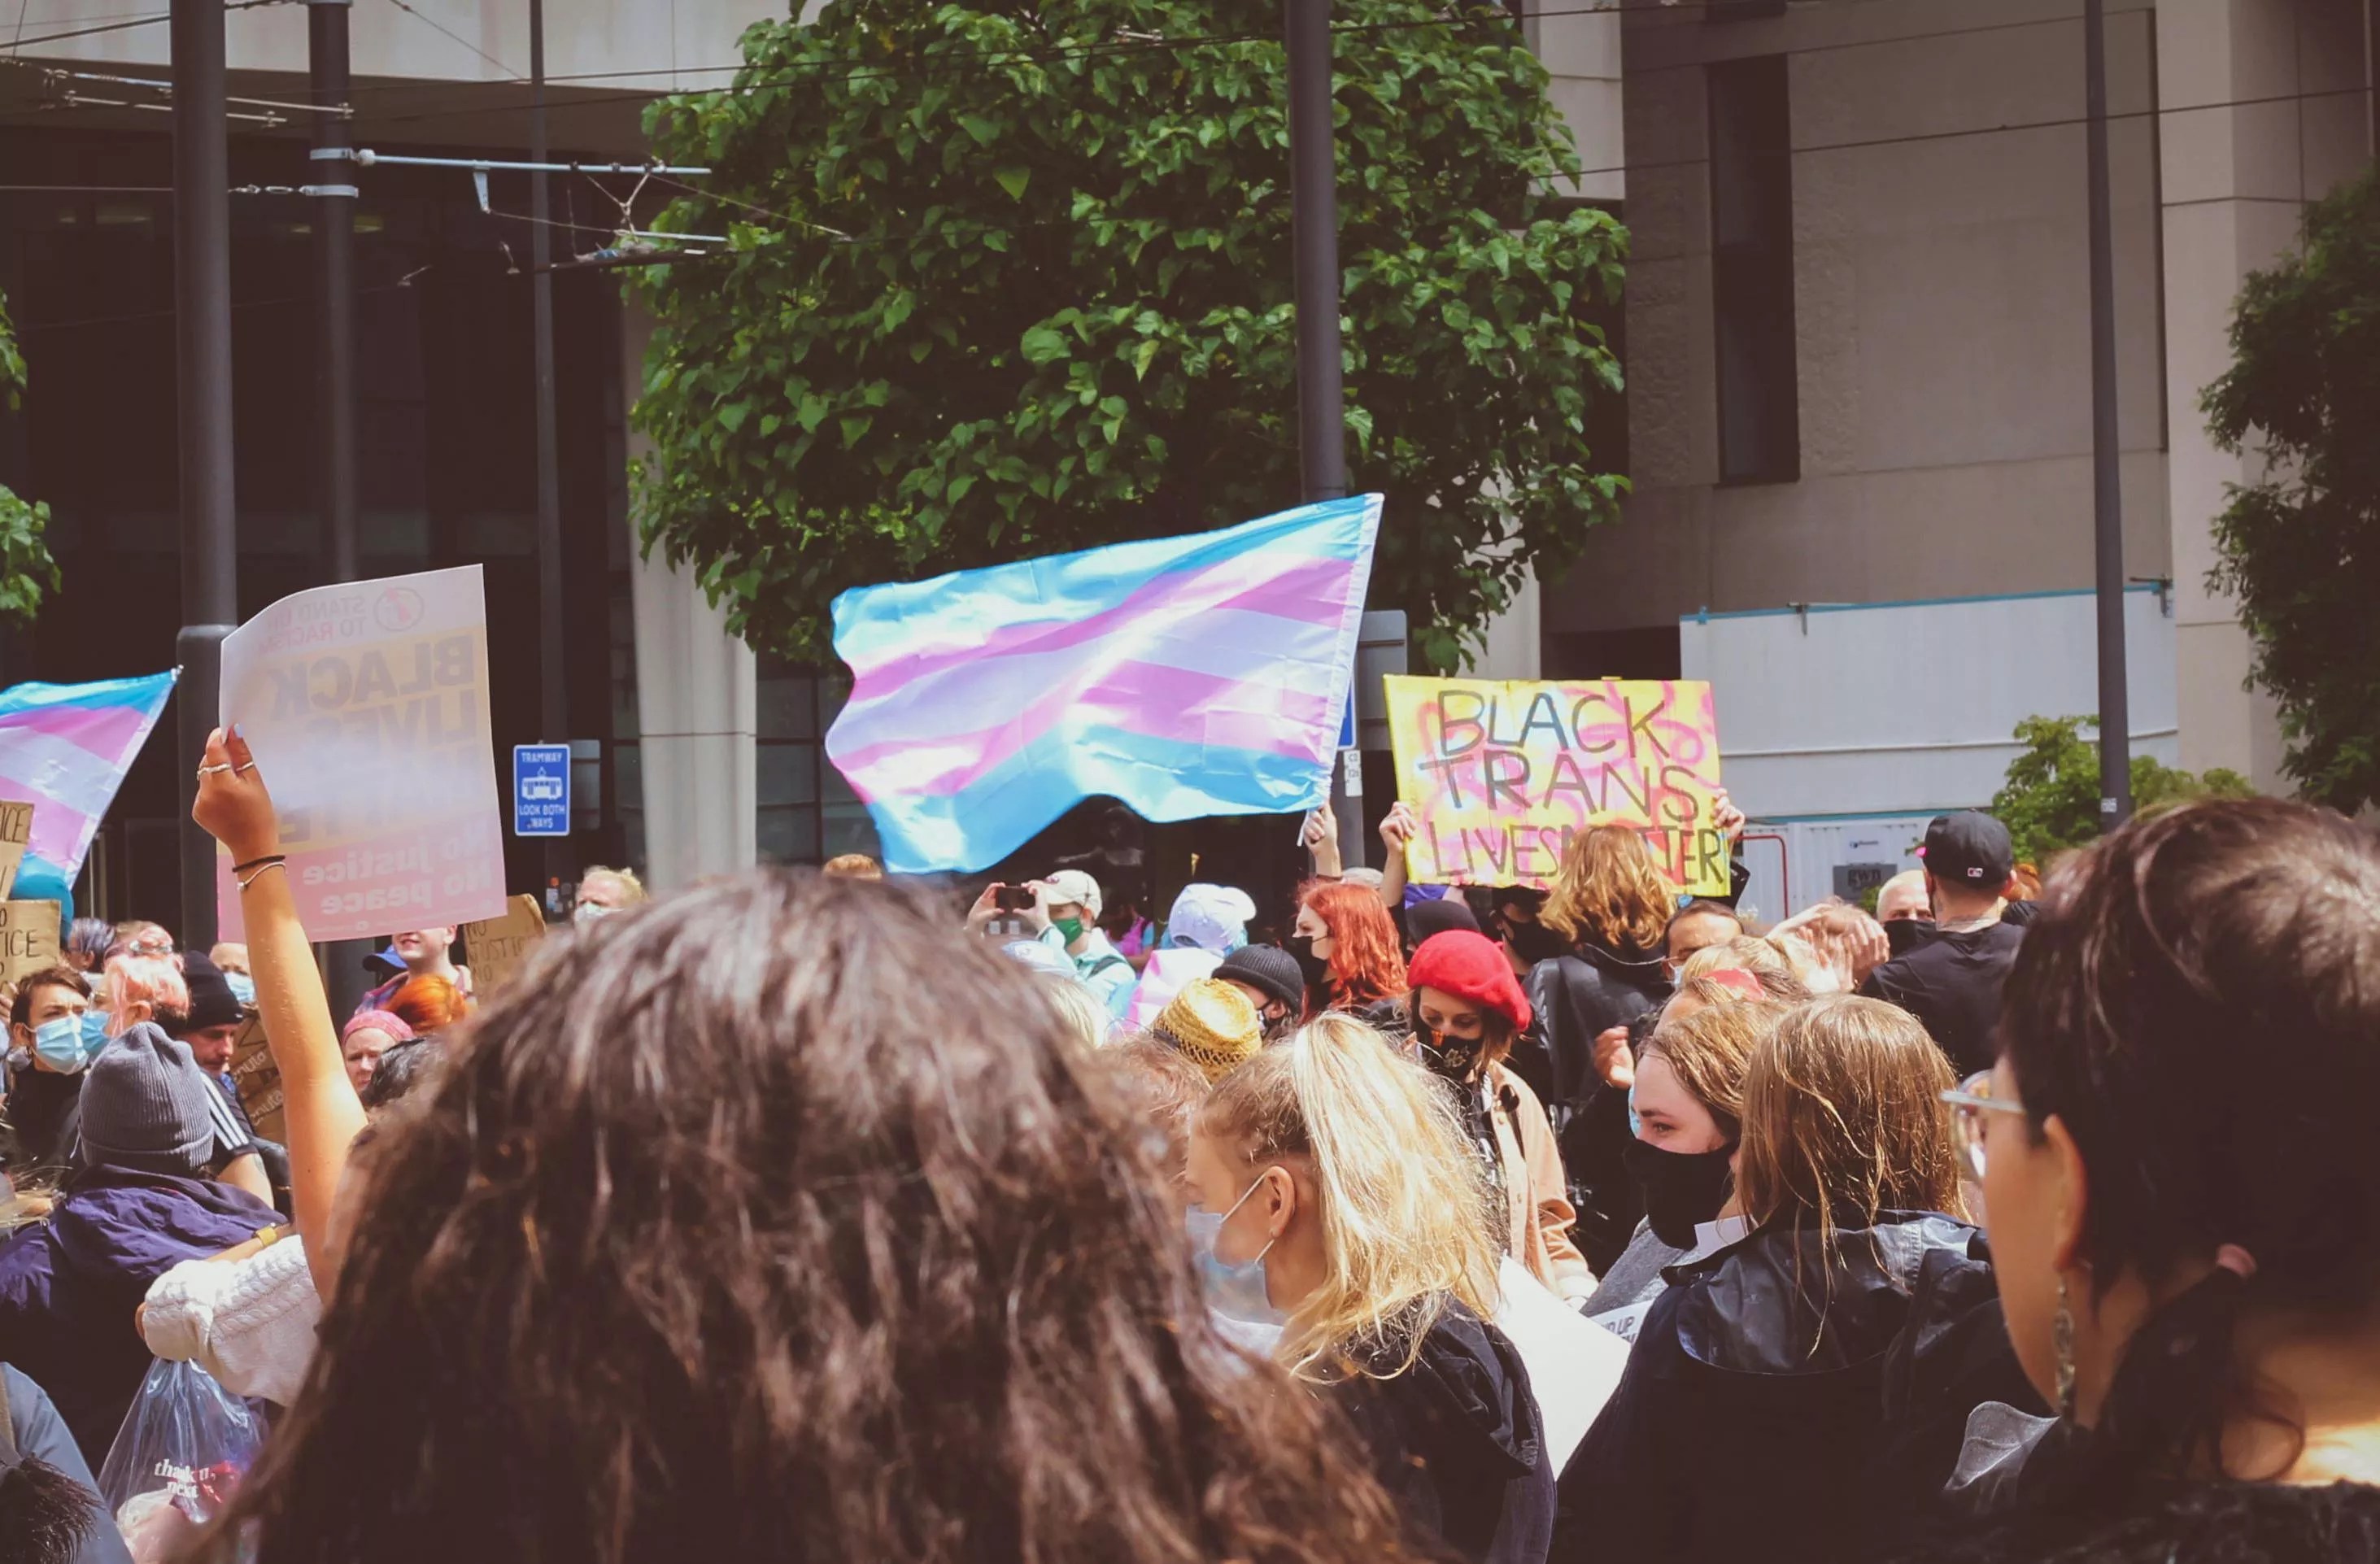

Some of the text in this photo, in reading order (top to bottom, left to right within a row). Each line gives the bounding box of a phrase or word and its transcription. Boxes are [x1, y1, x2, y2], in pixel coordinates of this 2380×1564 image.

[1438, 689, 1671, 759] BLACK
[521, 752, 562, 763] TRAMWAY
[1418, 749, 1699, 823] TRANS
[519, 804, 565, 816] LOOK BOTH
[1429, 821, 1559, 878] LIVES
[154, 1458, 197, 1483] thank
[167, 1481, 199, 1498] next
